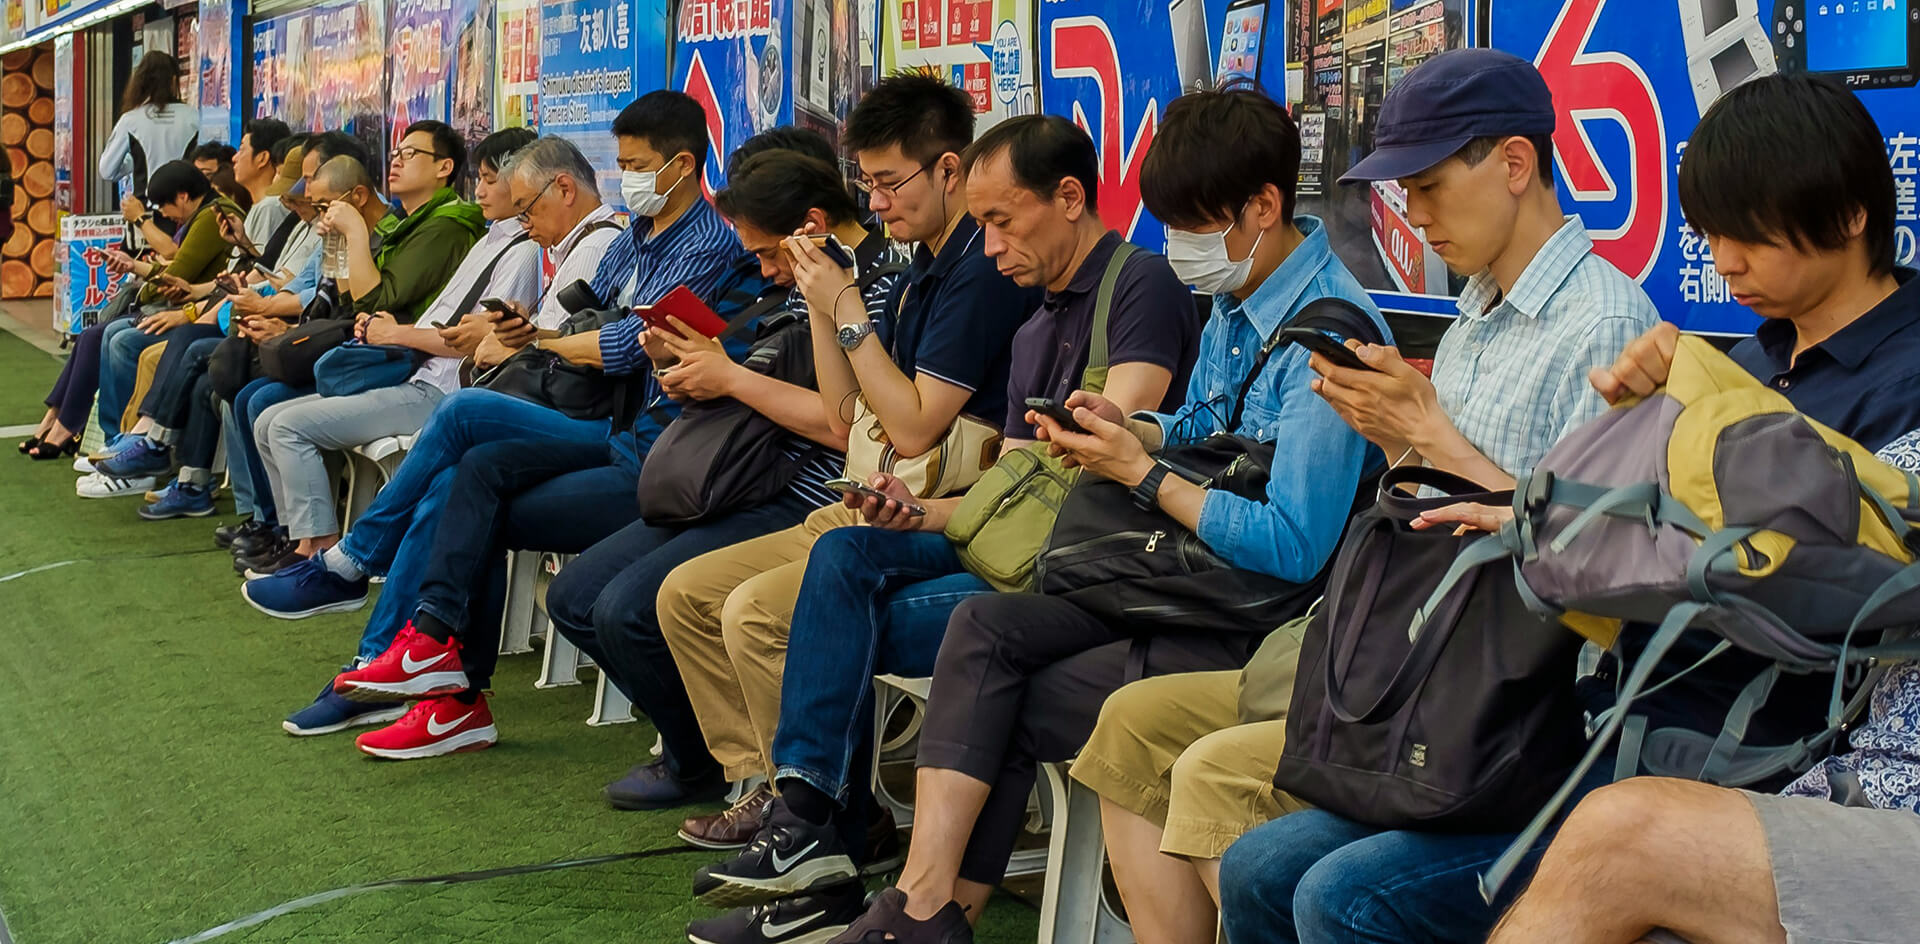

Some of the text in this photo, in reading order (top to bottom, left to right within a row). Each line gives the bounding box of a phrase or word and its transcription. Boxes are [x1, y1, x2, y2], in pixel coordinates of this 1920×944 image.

[580, 3, 630, 54] 友都八喜
[996, 36, 1017, 48] YOU ARE
[543, 72, 571, 103] Shinjuku
[603, 66, 631, 99] largest
[998, 78, 1017, 92] HERE
[1846, 74, 1870, 85] PSP
[543, 101, 568, 126] Camera
[1391, 228, 1414, 277] au
